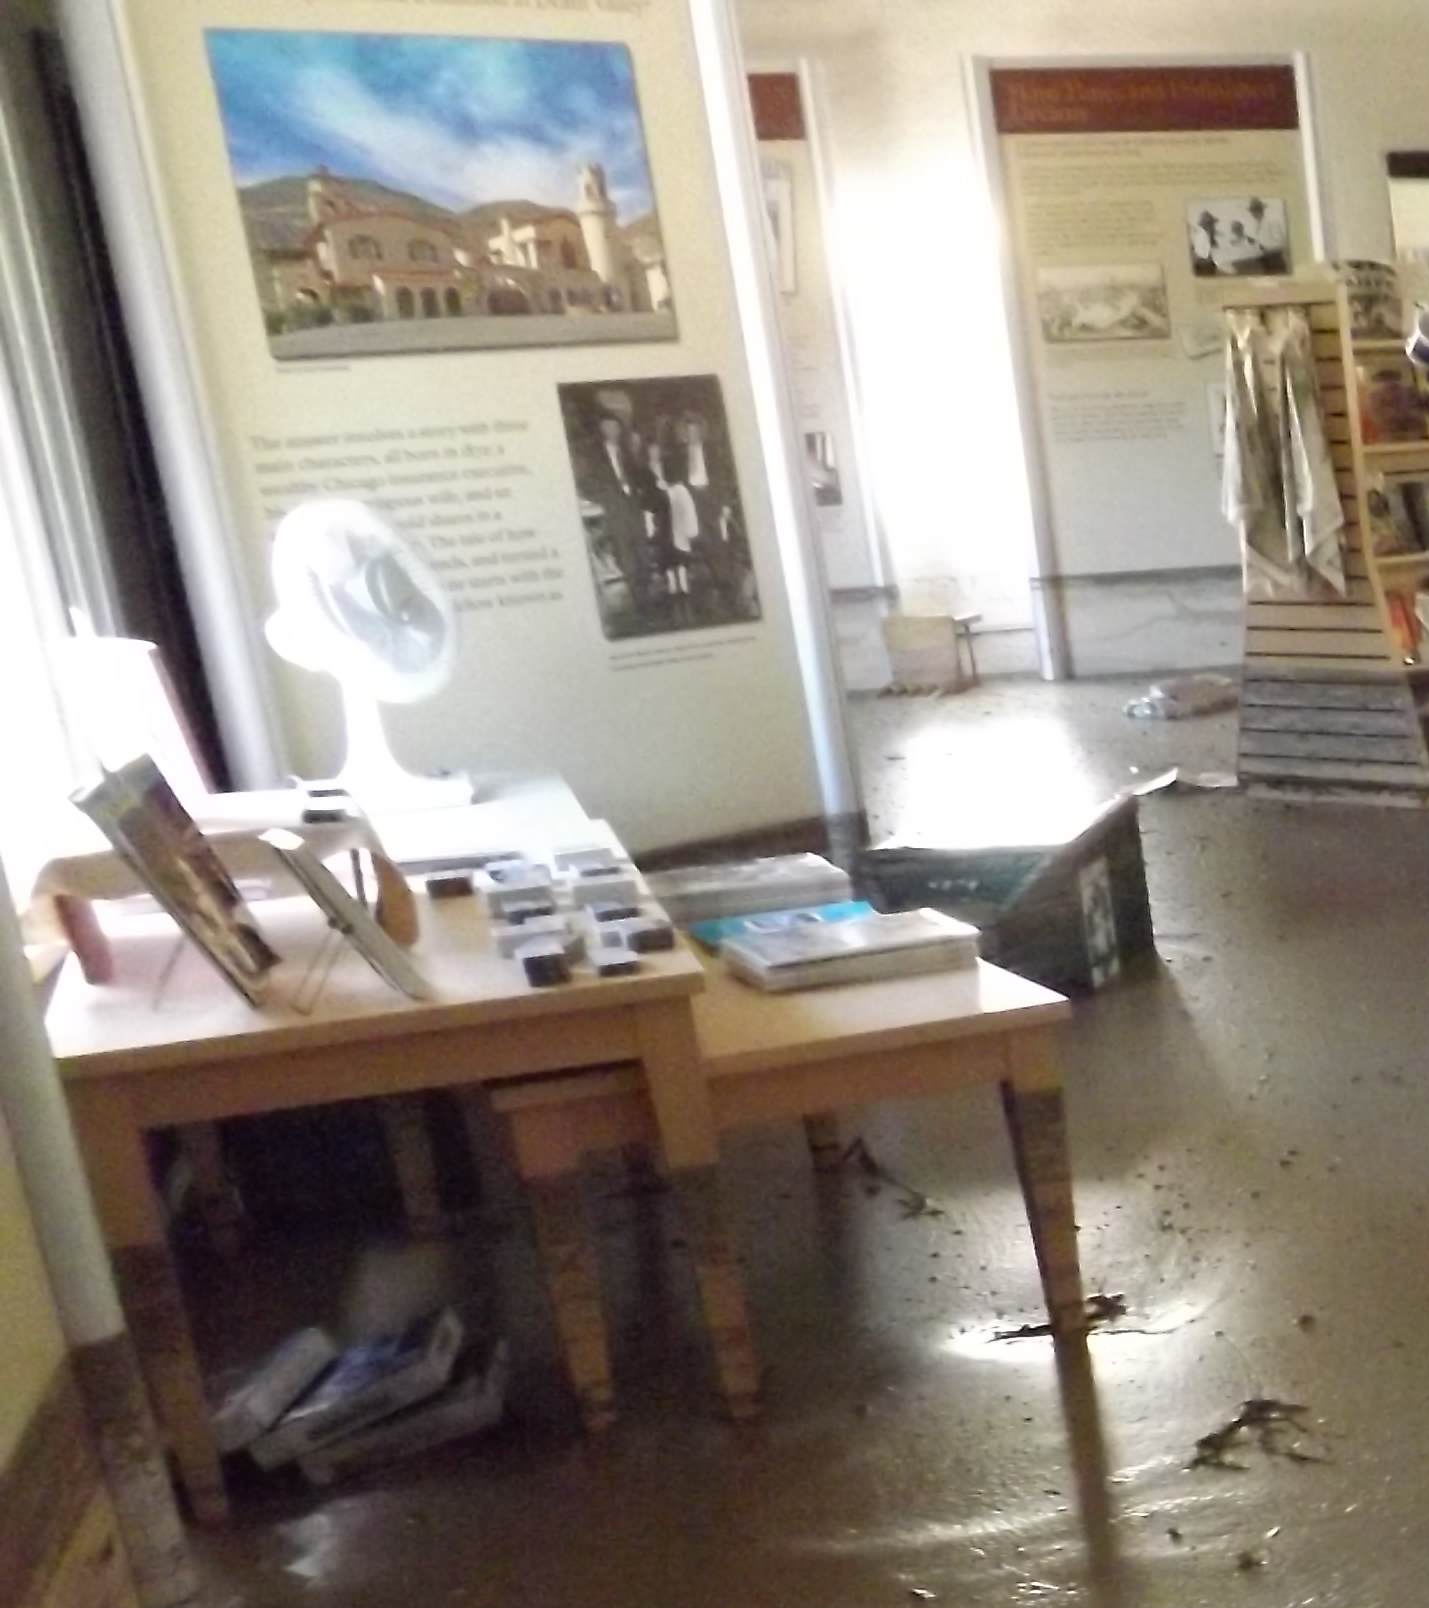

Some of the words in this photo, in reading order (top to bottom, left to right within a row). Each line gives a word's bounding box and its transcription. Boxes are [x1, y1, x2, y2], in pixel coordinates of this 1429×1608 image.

[250, 434, 281, 450] The
[298, 452, 381, 470] characters,
[403, 446, 440, 461] born
[322, 477, 385, 494] Chicago
[388, 471, 458, 486] insurance
[466, 487, 492, 501] and
[430, 534, 457, 549] The
[488, 529, 504, 543] of
